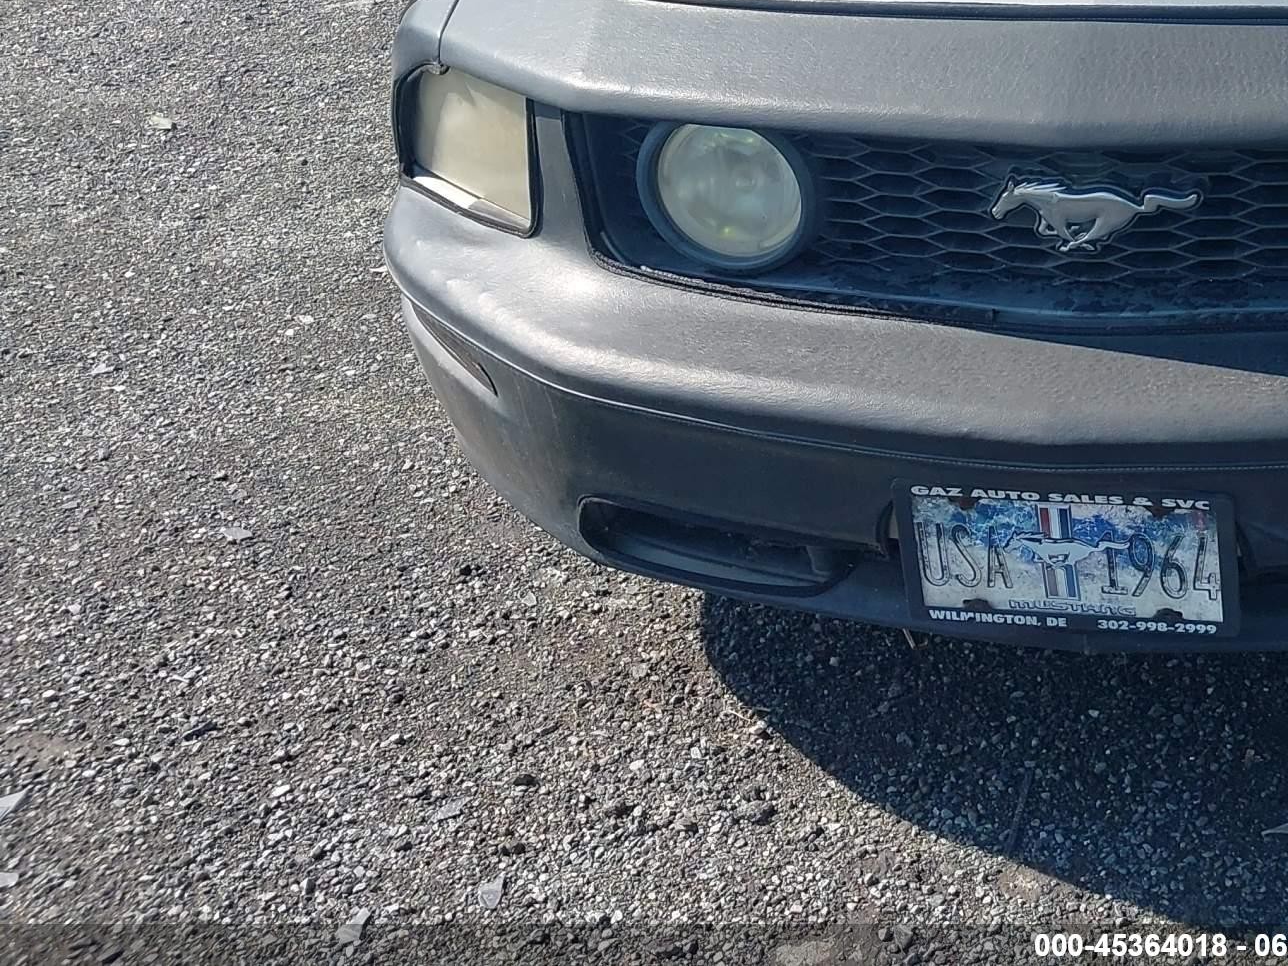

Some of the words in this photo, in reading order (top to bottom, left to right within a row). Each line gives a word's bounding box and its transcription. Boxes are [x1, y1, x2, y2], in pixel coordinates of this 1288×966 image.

[910, 485, 963, 497] GAZ
[970, 488, 1040, 501] AUTO
[1048, 493, 1124, 506] SALES
[1132, 497, 1154, 507] &
[1161, 498, 1210, 511] SVC
[914, 521, 1014, 588] USA
[1100, 530, 1221, 601] 1964
[1046, 617, 1068, 627] DE
[1097, 618, 1217, 634] 302-998-2999
